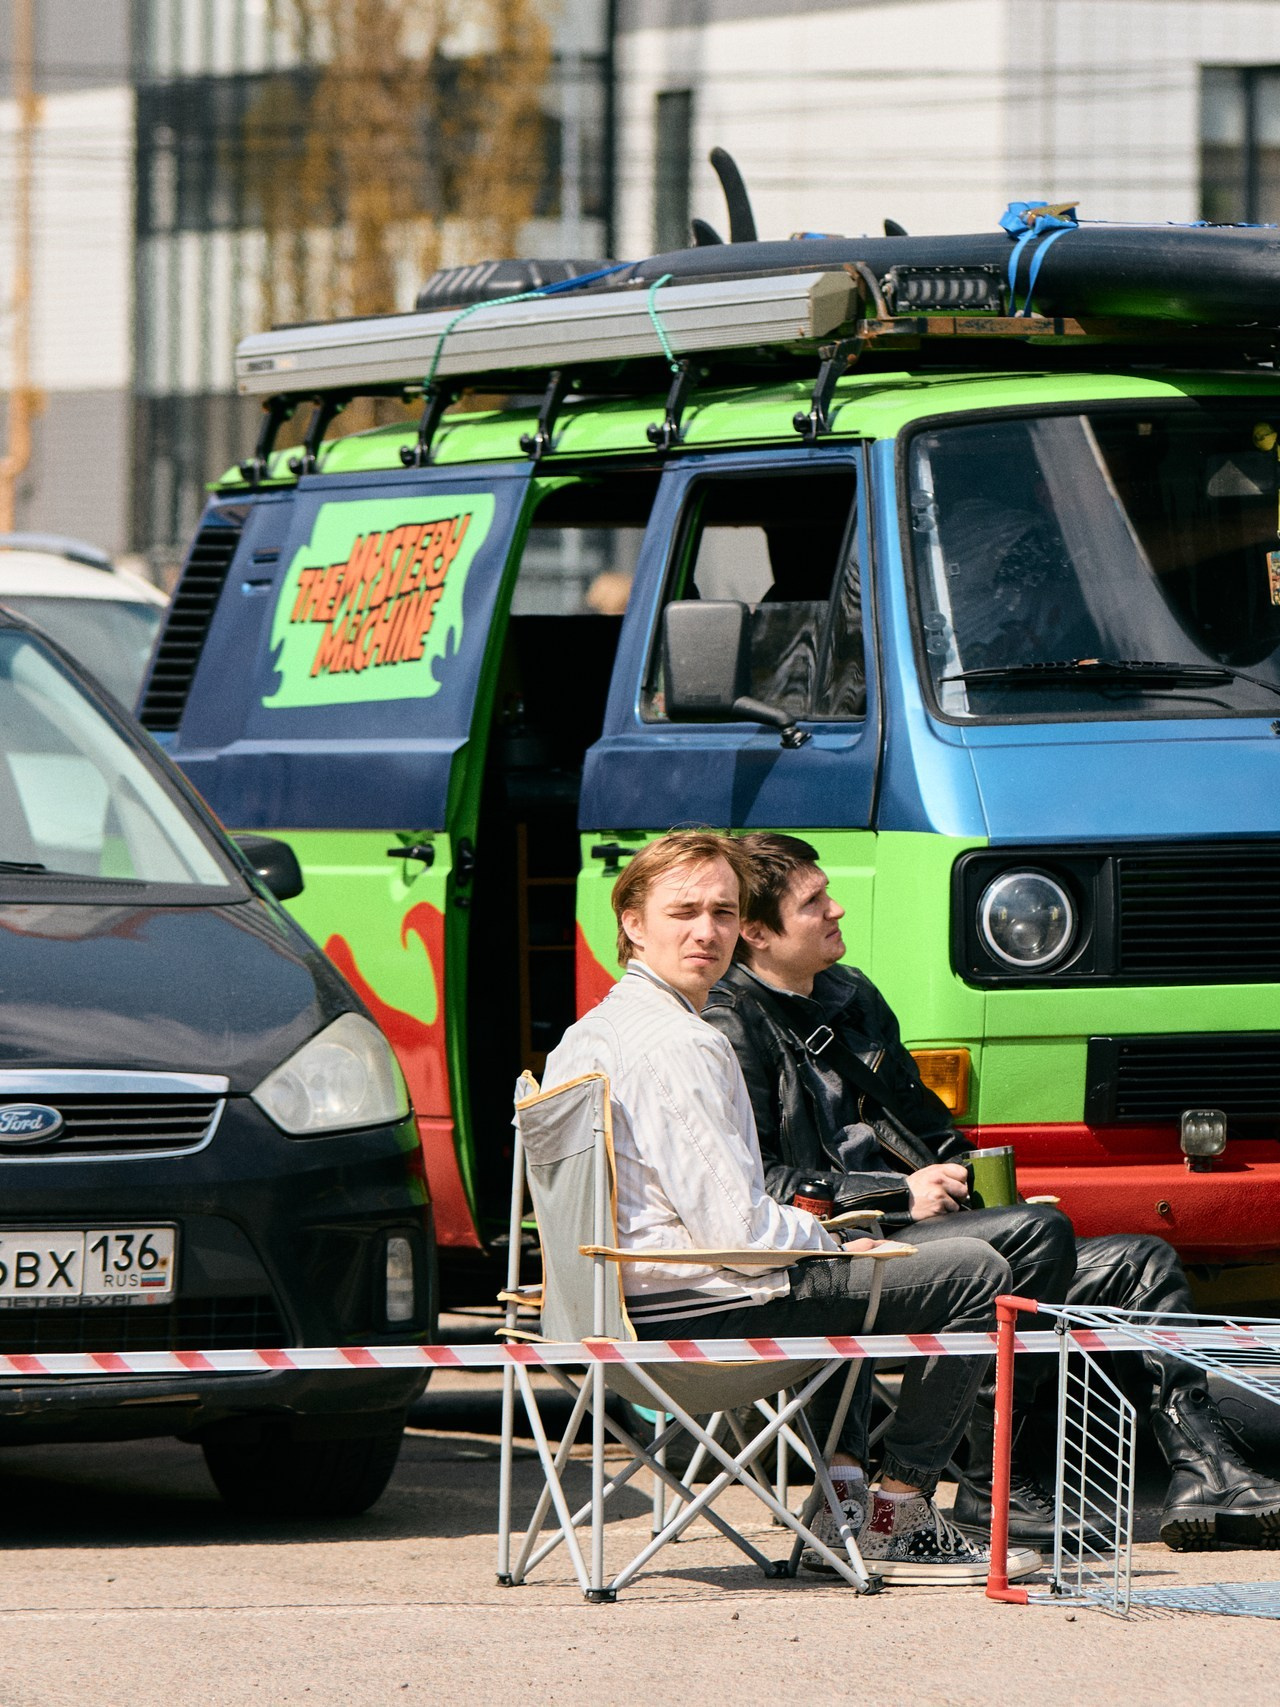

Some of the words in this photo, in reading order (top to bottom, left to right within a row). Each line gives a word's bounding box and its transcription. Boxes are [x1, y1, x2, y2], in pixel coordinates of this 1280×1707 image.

[290, 561, 349, 624] THE
[346, 512, 473, 615] MYSTERY
[309, 582, 446, 678] MACHINE
[0, 1111, 43, 1132] Ford
[91, 1233, 159, 1272] 136
[104, 1274, 139, 1287] RUS
